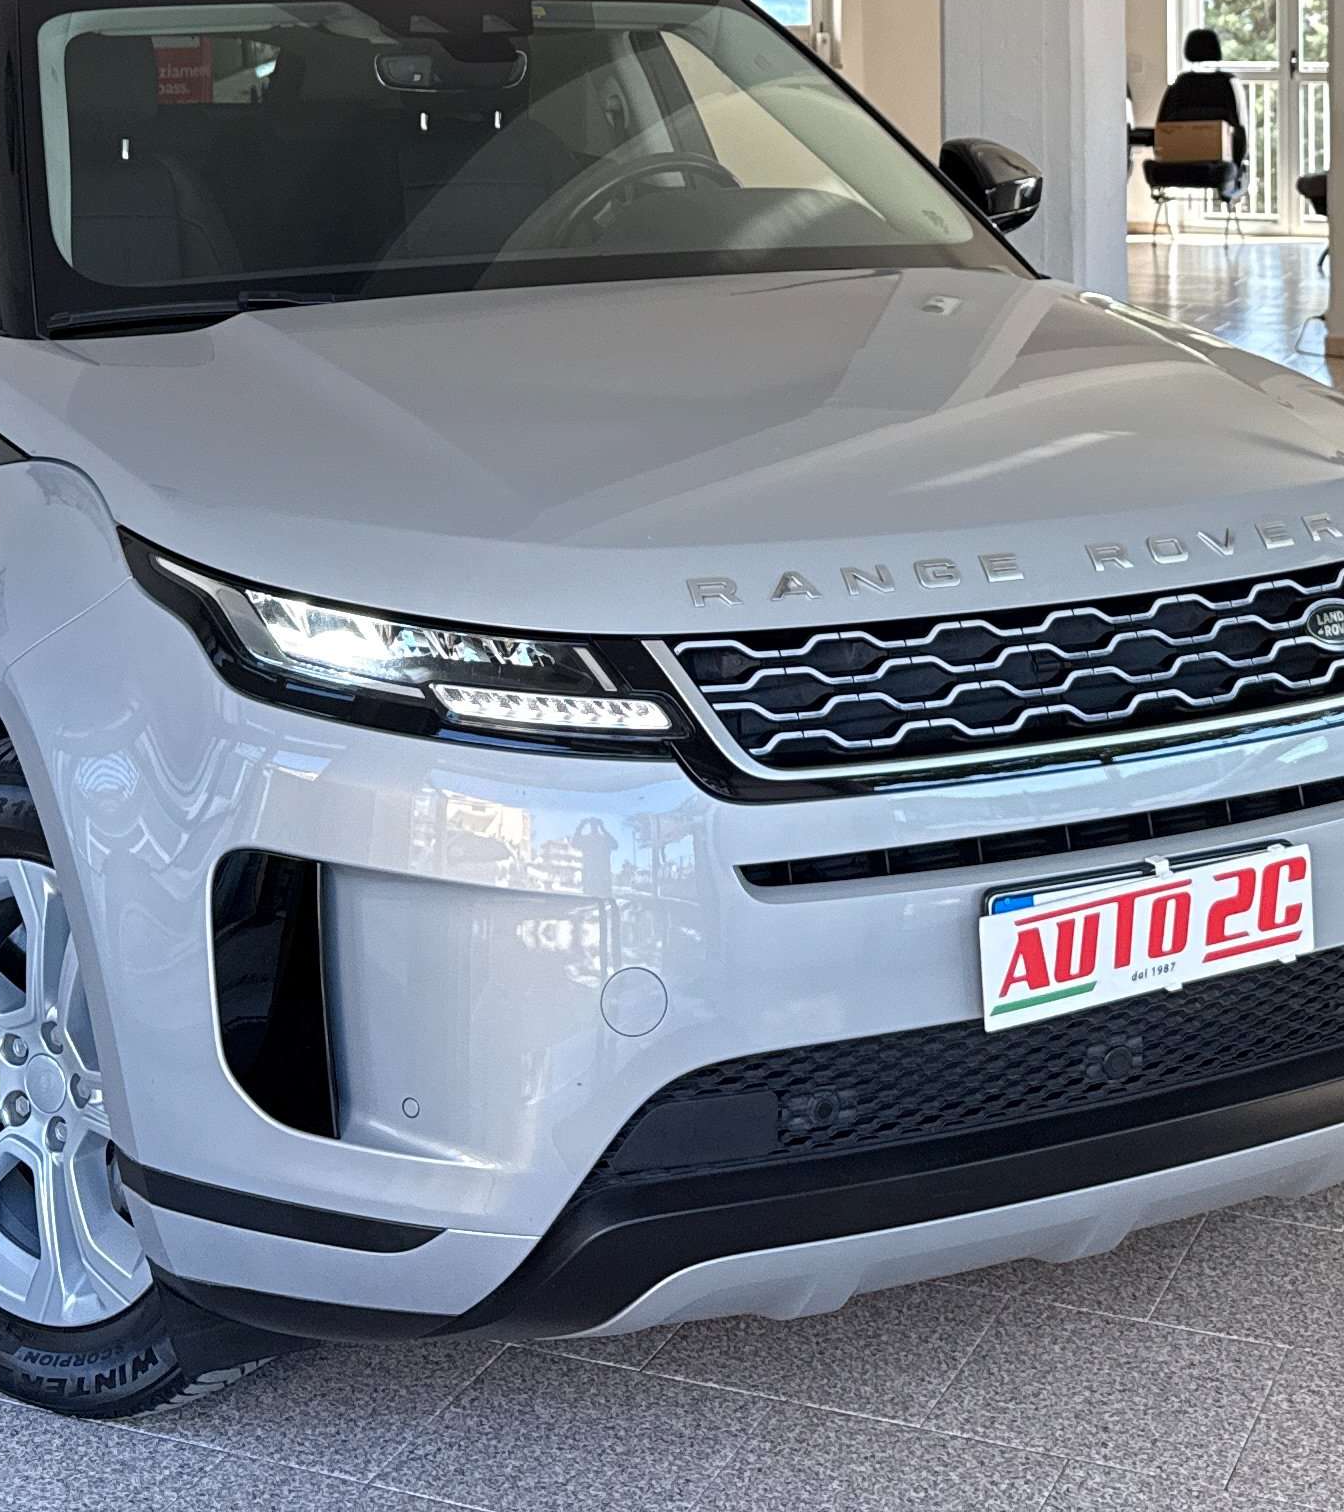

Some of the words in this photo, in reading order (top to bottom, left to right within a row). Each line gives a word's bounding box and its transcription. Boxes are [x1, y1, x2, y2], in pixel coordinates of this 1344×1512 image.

[685, 552, 1026, 608] RANGE
[1084, 511, 1344, 572] ROVER
[1316, 610, 1344, 626] LAND
[998, 878, 1192, 998] AUTO
[1206, 855, 1307, 946] 2C
[1131, 968, 1148, 982] dal
[1151, 961, 1176, 977] 1987
[21, 1345, 159, 1398] WINTER
